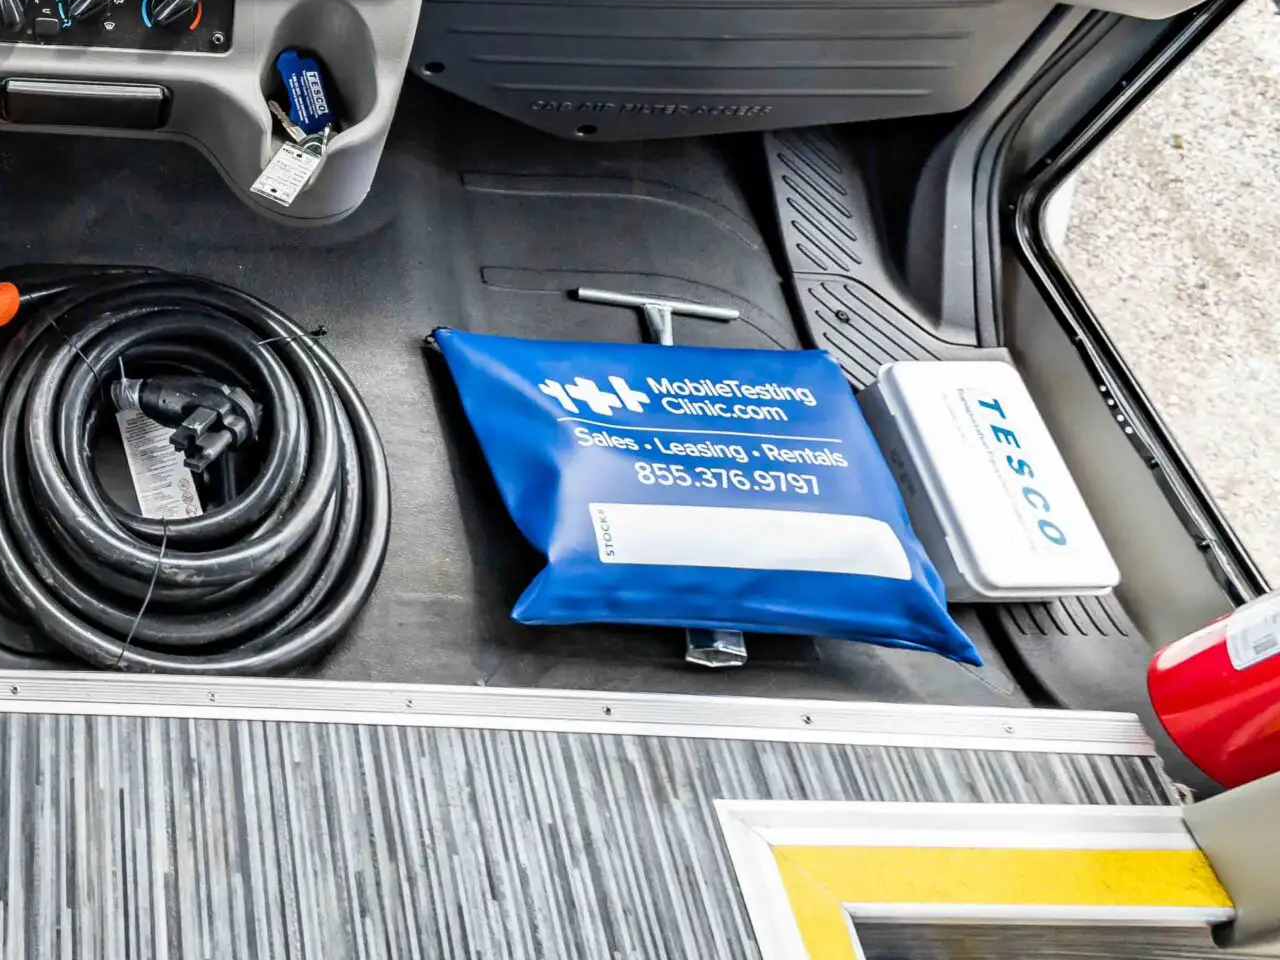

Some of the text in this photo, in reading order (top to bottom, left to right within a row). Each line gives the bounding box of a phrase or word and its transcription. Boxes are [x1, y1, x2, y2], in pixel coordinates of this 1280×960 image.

[308, 71, 327, 113] TESCO
[646, 376, 816, 407] MobileTesting
[661, 396, 789, 421] Clinic.com
[574, 427, 849, 468] Sales Leasing Rentals
[633, 461, 820, 495] 855.376.9797
[978, 398, 1067, 546] TESCO
